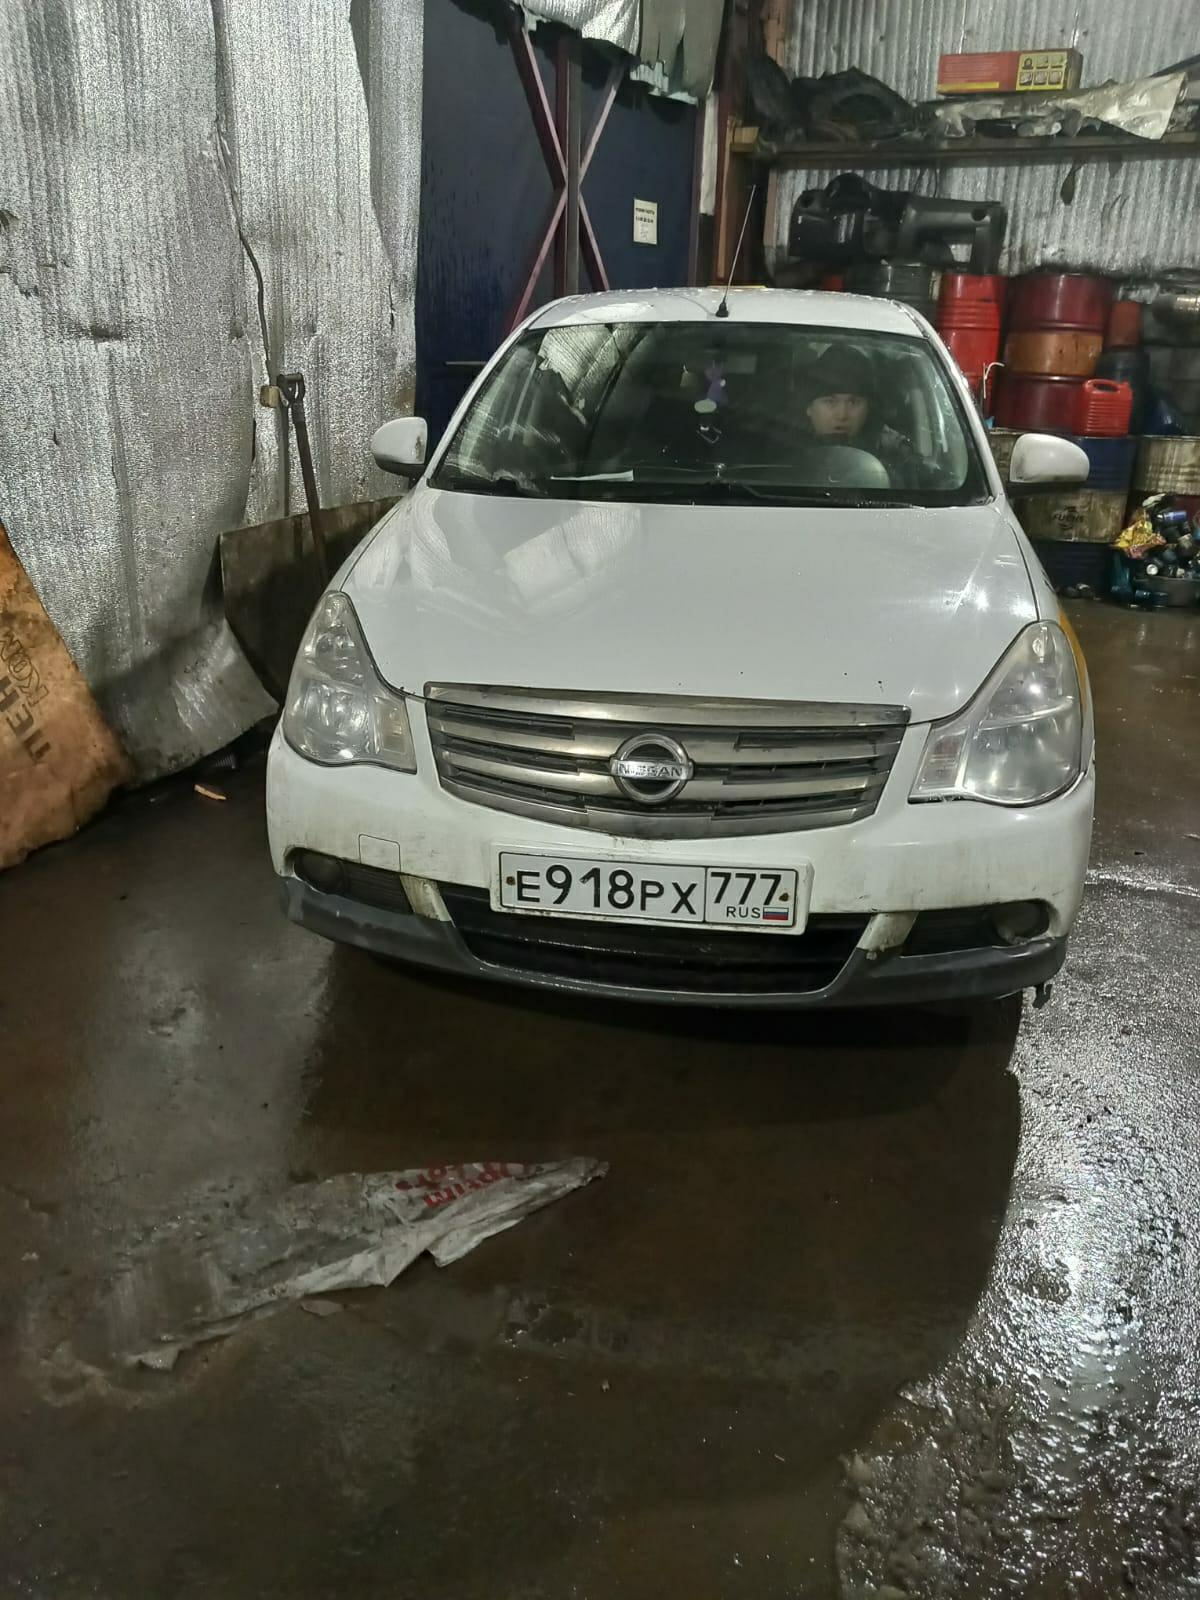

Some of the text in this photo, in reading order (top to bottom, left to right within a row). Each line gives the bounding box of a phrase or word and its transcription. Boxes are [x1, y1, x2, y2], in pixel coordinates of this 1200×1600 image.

[617, 763, 682, 777] NISSAN
[710, 871, 783, 906] 777
[726, 906, 761, 919] RUS
